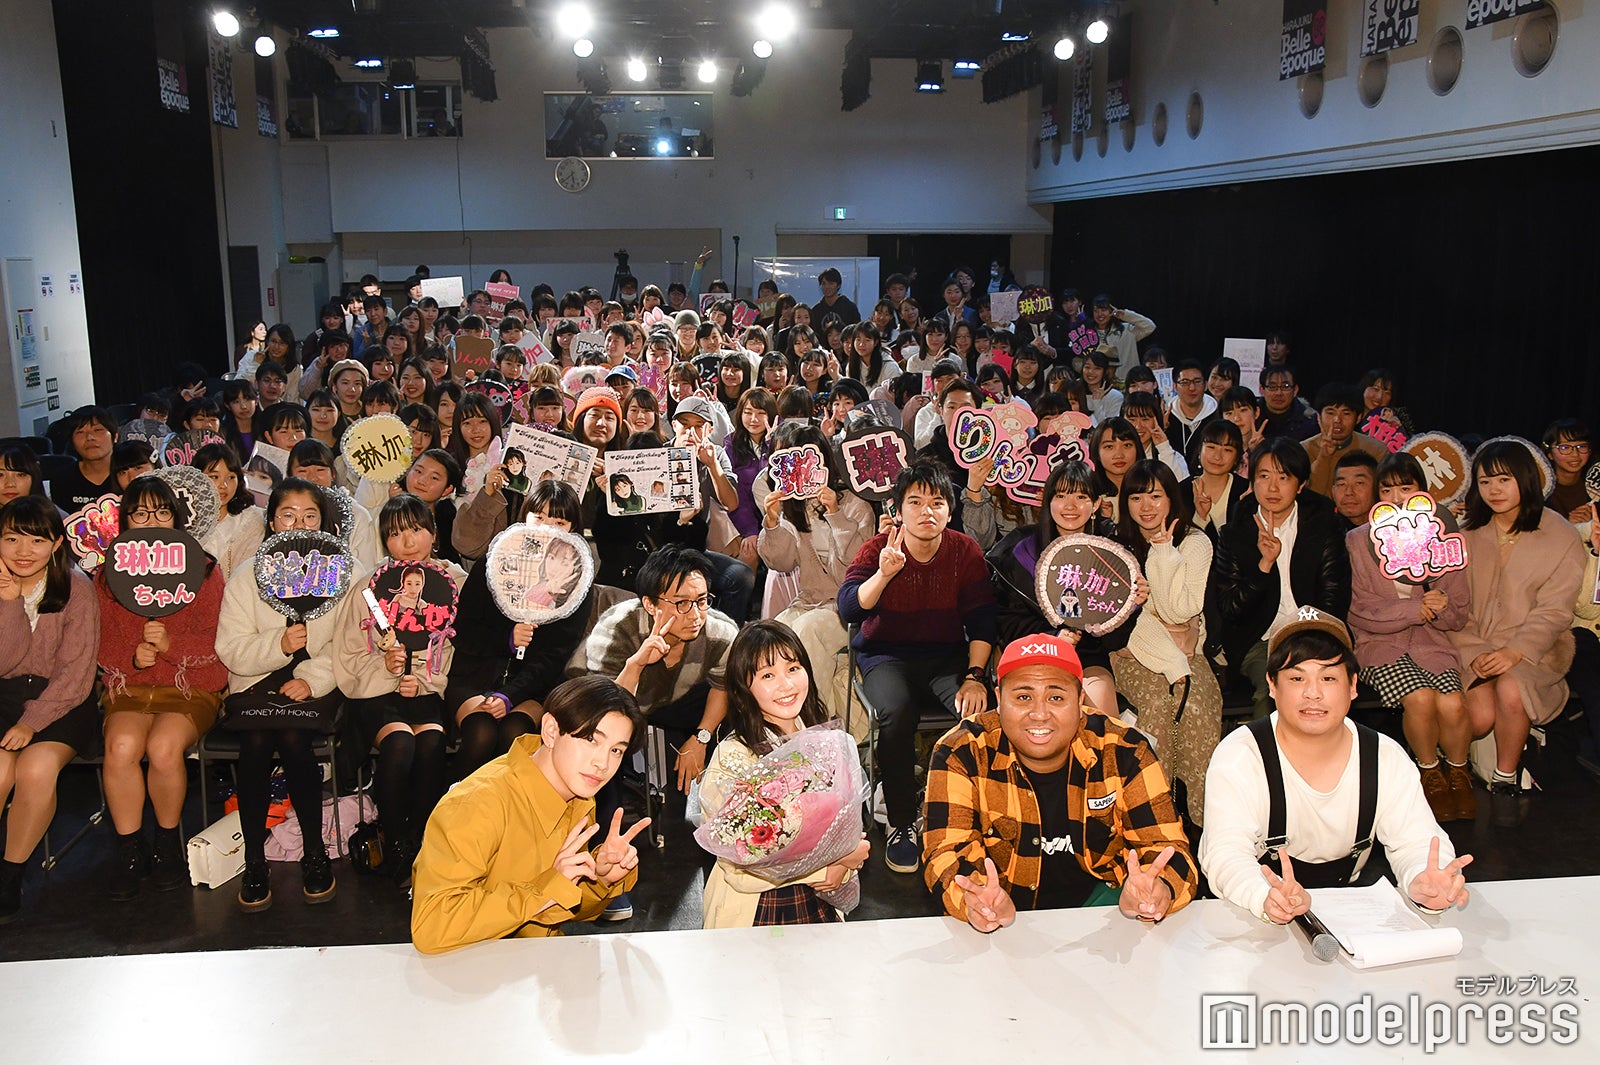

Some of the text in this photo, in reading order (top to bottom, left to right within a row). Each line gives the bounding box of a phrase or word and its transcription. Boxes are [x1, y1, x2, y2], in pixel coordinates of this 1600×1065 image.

[1281, 13, 1313, 32] HARAJUKU
[1281, 28, 1311, 57] Belle
[158, 67, 180, 92] Belle
[1019, 295, 1053, 315] 琳加
[518, 429, 563, 449] Happy Birthday
[1361, 414, 1408, 454] 大好き
[352, 434, 406, 474] 琳加
[615, 452, 661, 461] Happy Birthday
[114, 540, 187, 577] 琳加
[1056, 564, 1111, 596] 琳加
[132, 583, 196, 609] ちゃん
[1087, 596, 1119, 614] ちゃん
[1021, 643, 1058, 657] XXIII
[240, 708, 320, 718] HONEY MI HONEY
